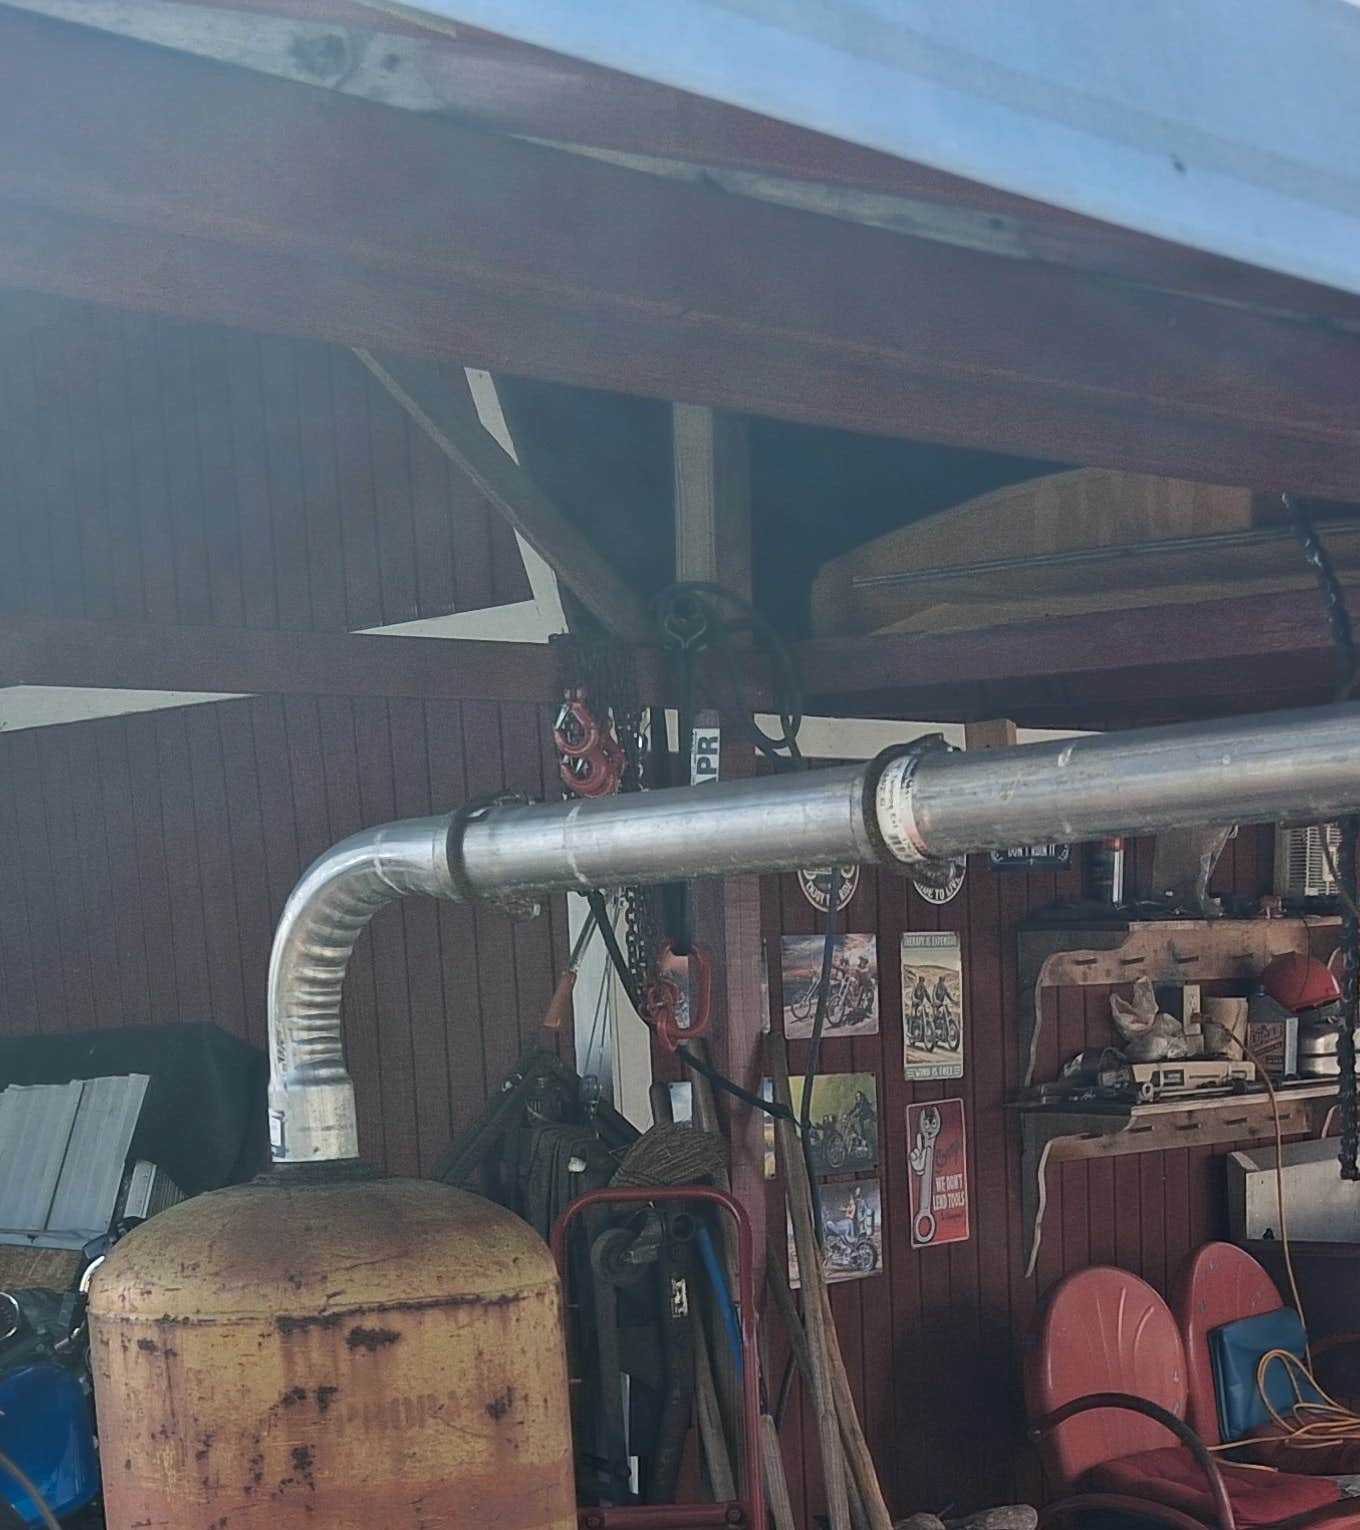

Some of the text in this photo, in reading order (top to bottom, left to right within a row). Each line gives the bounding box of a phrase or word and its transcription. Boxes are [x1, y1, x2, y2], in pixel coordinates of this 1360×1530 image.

[697, 736, 718, 784] PR
[934, 888, 945, 900] TO
[935, 1175, 946, 1193] WE
[932, 1190, 966, 1212] LEND TOOLS
